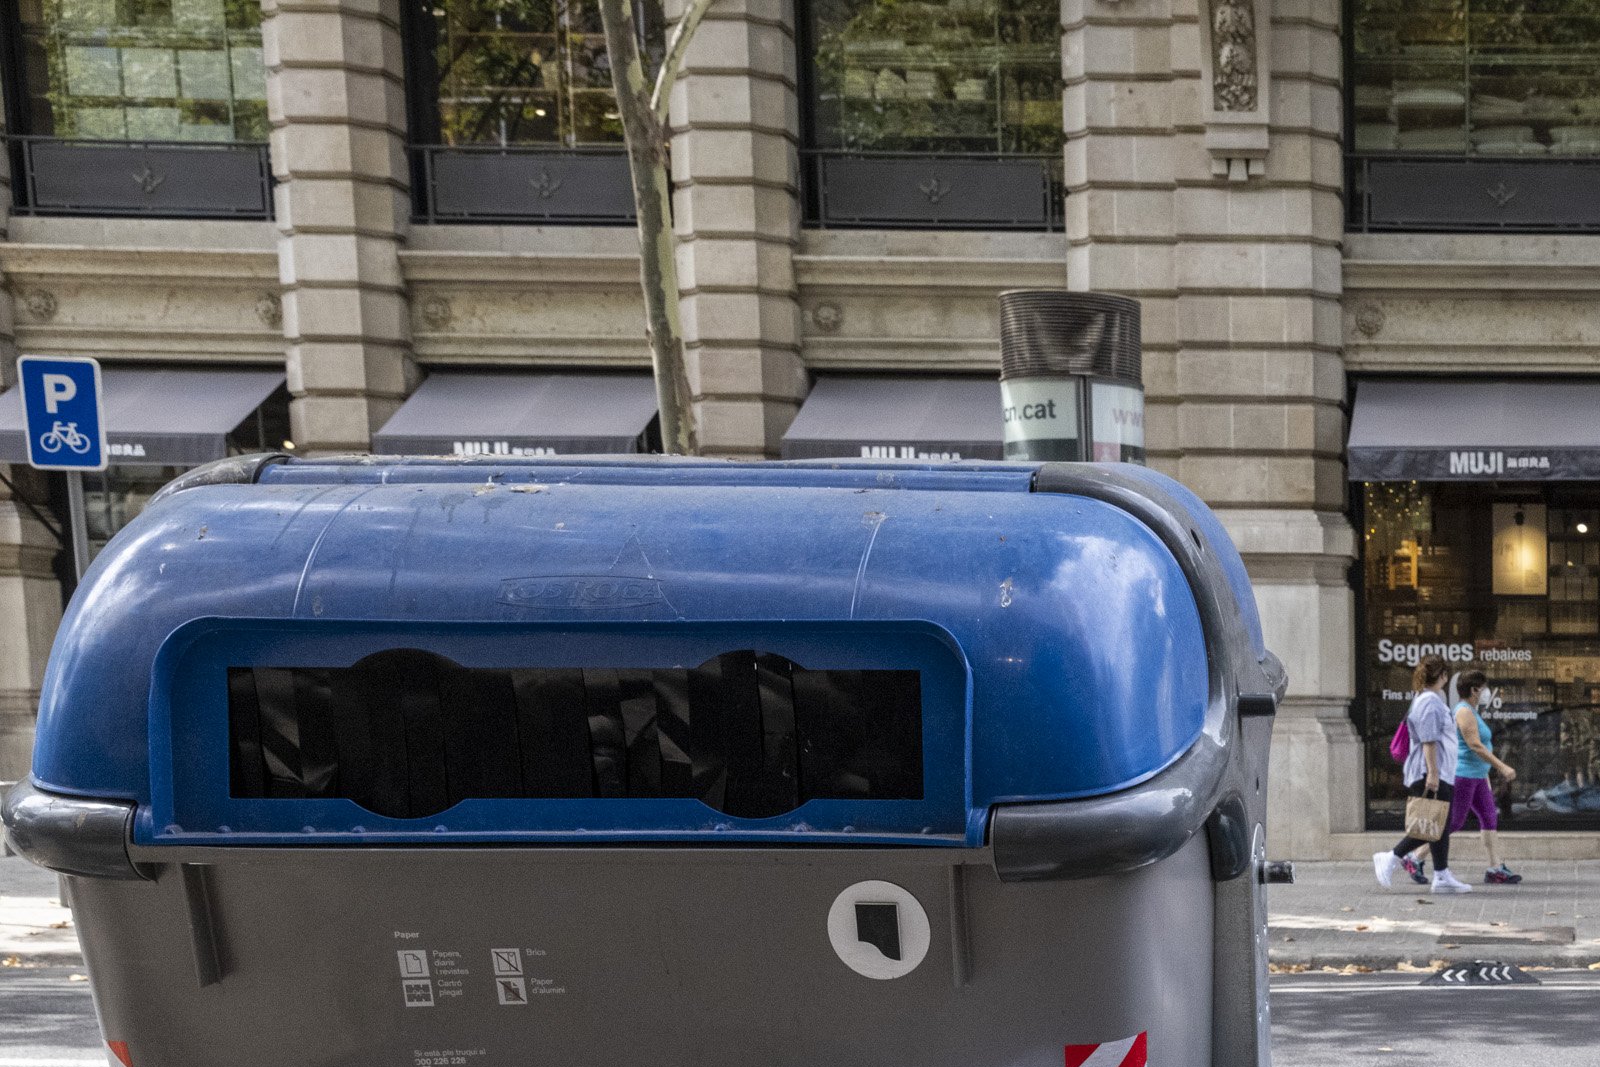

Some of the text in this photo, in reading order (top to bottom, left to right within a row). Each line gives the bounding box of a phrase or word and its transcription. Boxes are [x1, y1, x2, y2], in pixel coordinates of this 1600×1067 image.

[42, 373, 77, 414] P
[1450, 451, 1504, 474] MUJI
[1480, 647, 1533, 662] rebaixes
[1492, 710, 1538, 720] descompte
[394, 930, 420, 940] Paper
[530, 977, 553, 987] Paper
